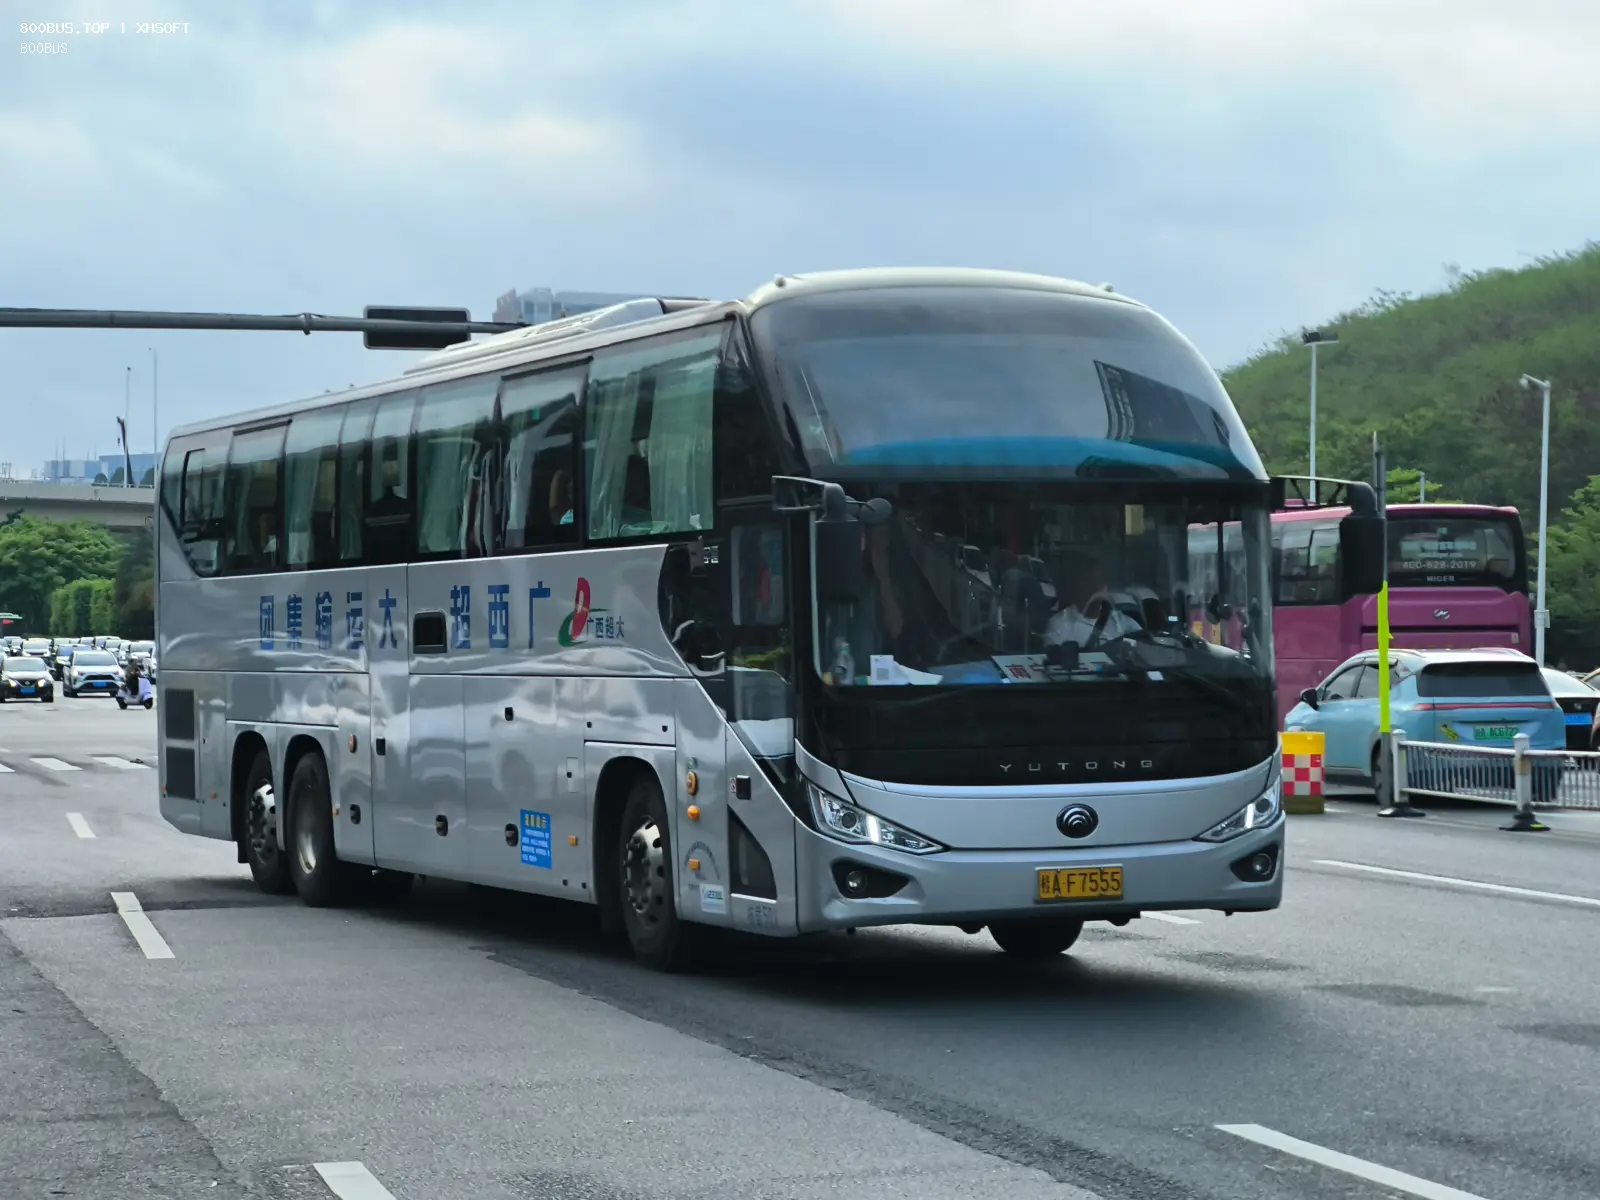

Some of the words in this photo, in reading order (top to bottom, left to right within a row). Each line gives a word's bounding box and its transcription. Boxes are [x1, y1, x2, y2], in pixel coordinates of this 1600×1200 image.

[587, 616, 625, 639] 广西超大
[1000, 760, 1153, 772] YUTONG
